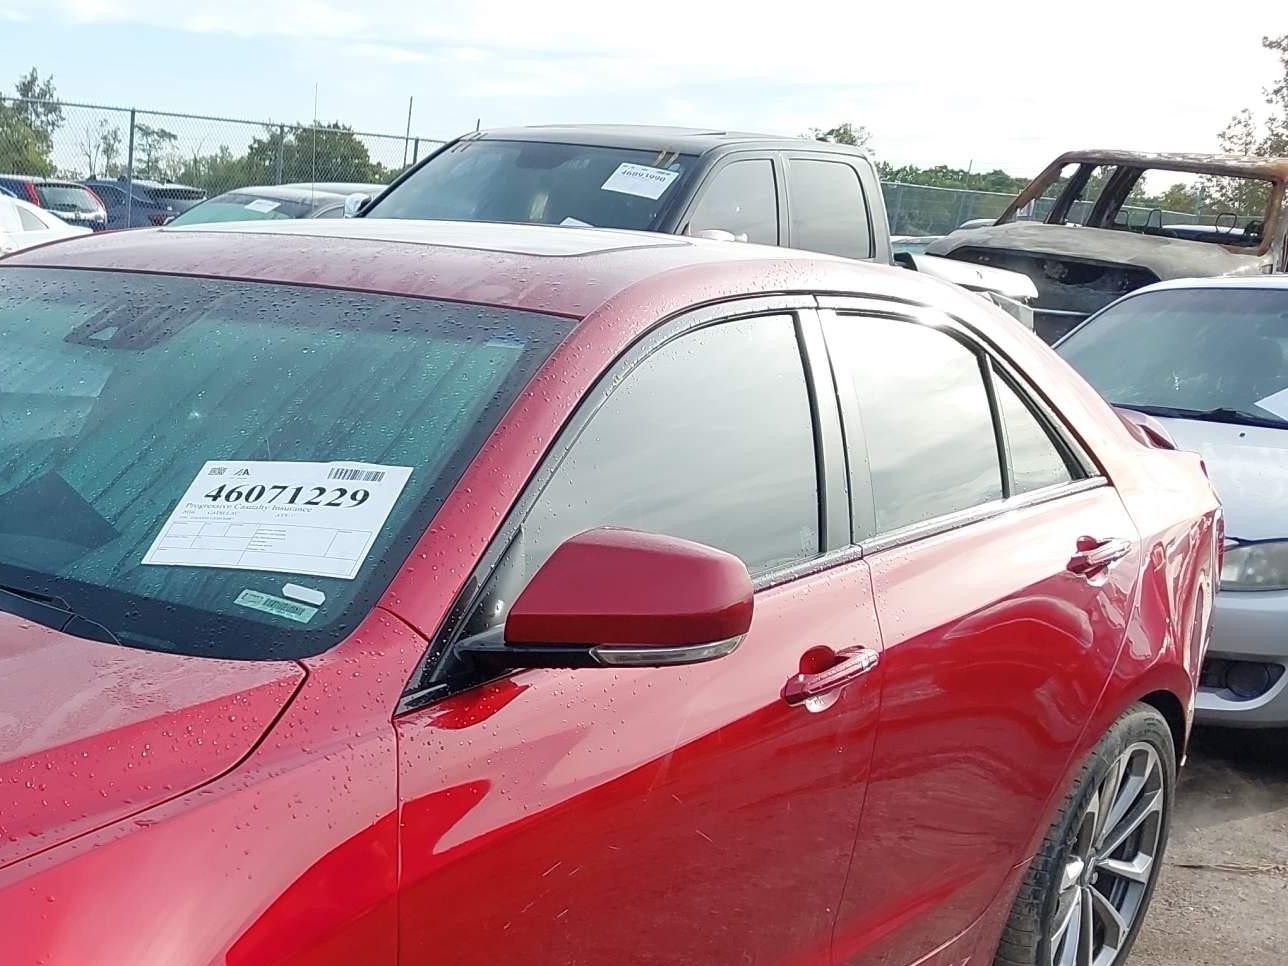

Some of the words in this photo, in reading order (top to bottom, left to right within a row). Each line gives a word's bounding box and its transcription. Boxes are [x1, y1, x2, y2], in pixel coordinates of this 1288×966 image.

[204, 483, 370, 508] 46071229
[186, 502, 232, 511] Progressive
[234, 503, 268, 511] Casualty
[271, 504, 312, 512] Insurance
